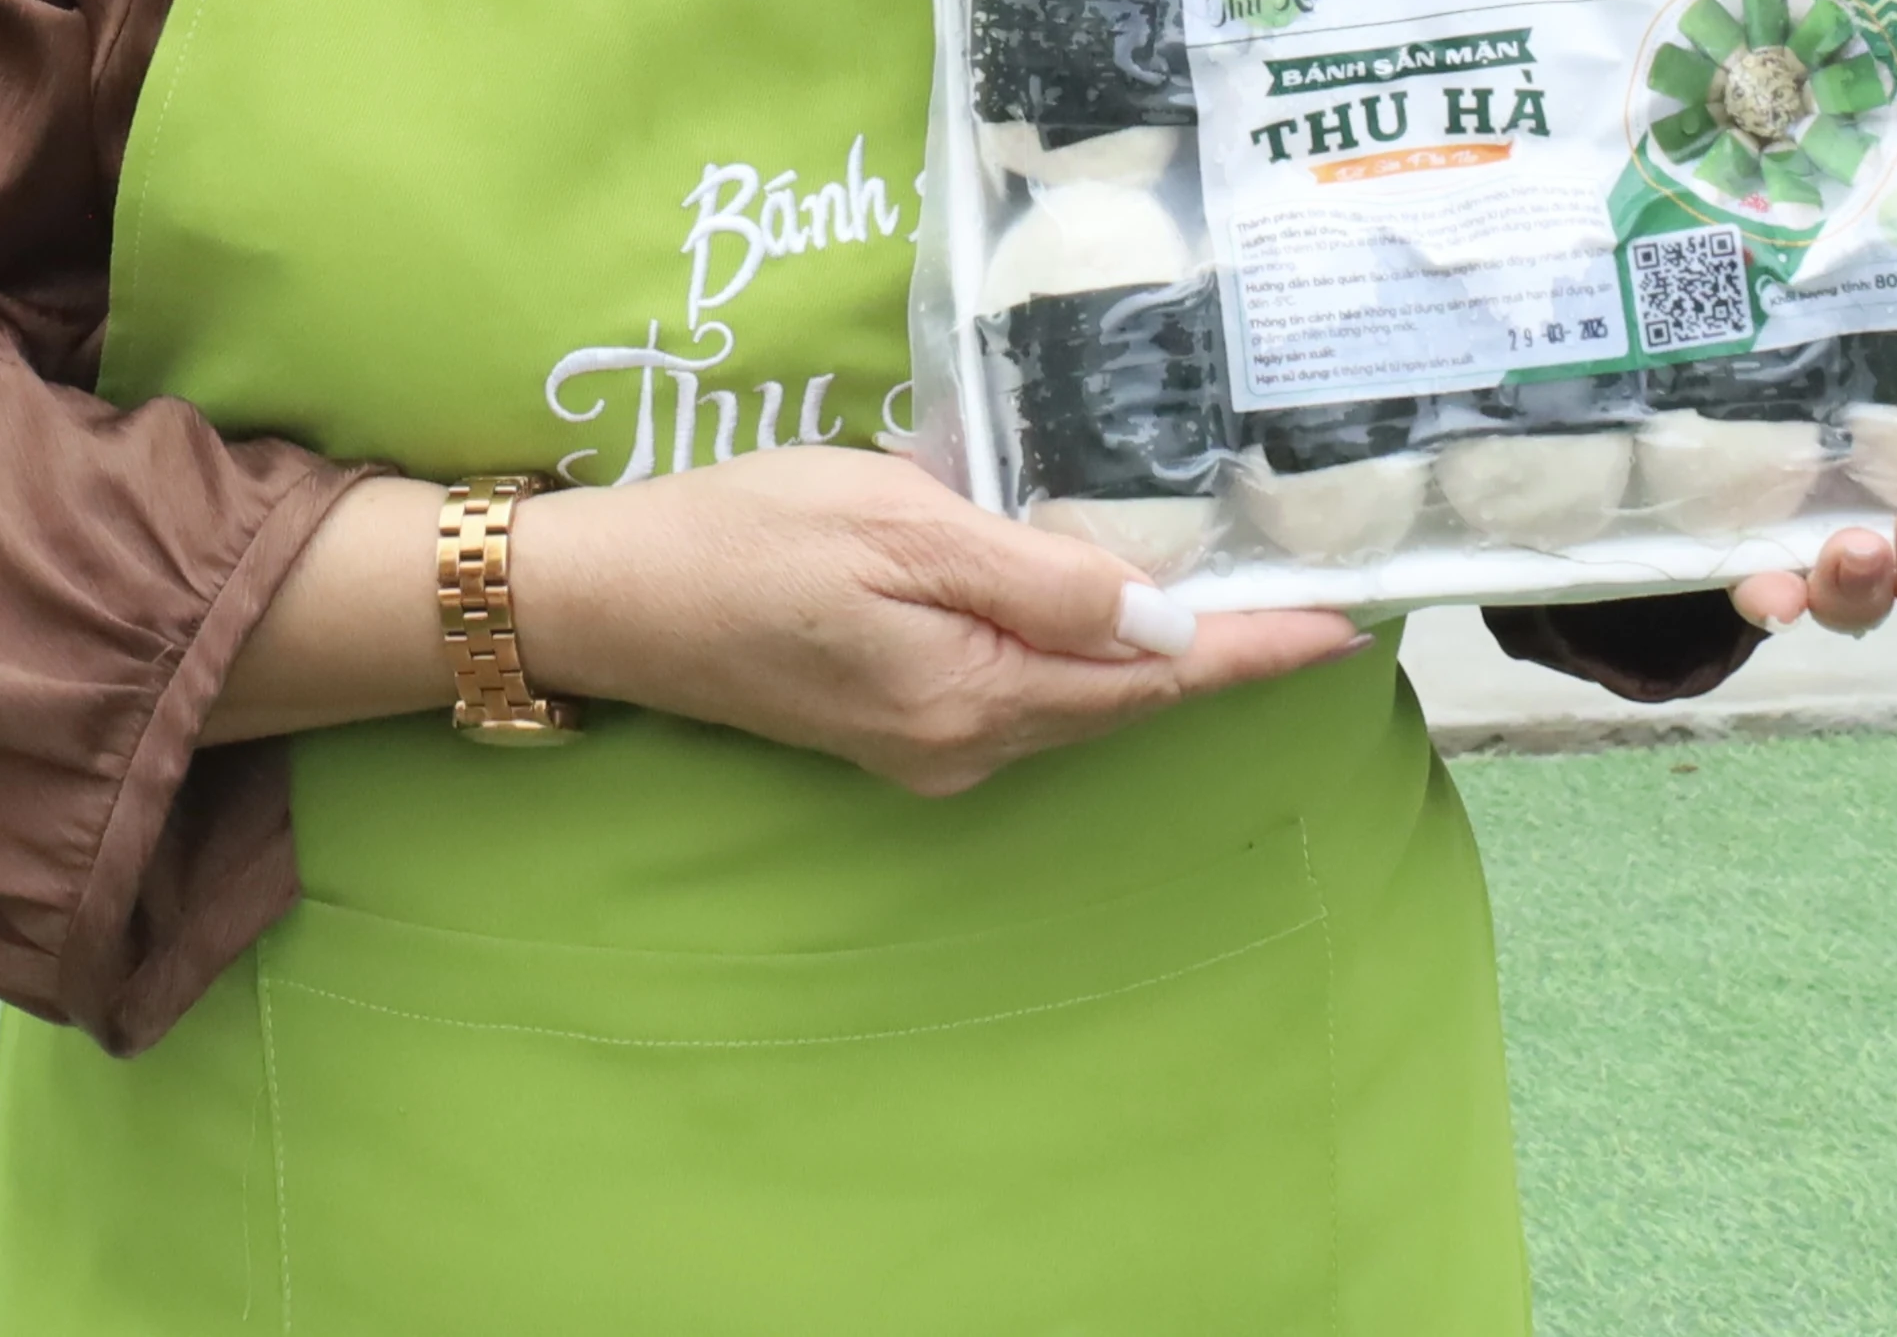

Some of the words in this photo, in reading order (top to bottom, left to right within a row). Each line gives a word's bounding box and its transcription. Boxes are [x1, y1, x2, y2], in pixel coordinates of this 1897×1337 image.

[1250, 91, 1409, 164] THU
[1442, 69, 1552, 138] HÀ
[1281, 60, 1366, 88] BÁNH
[1372, 45, 1437, 79] SẮN
[1444, 39, 1521, 66] MẶN
[681, 133, 899, 331] Bánh
[545, 319, 844, 488] Thu
